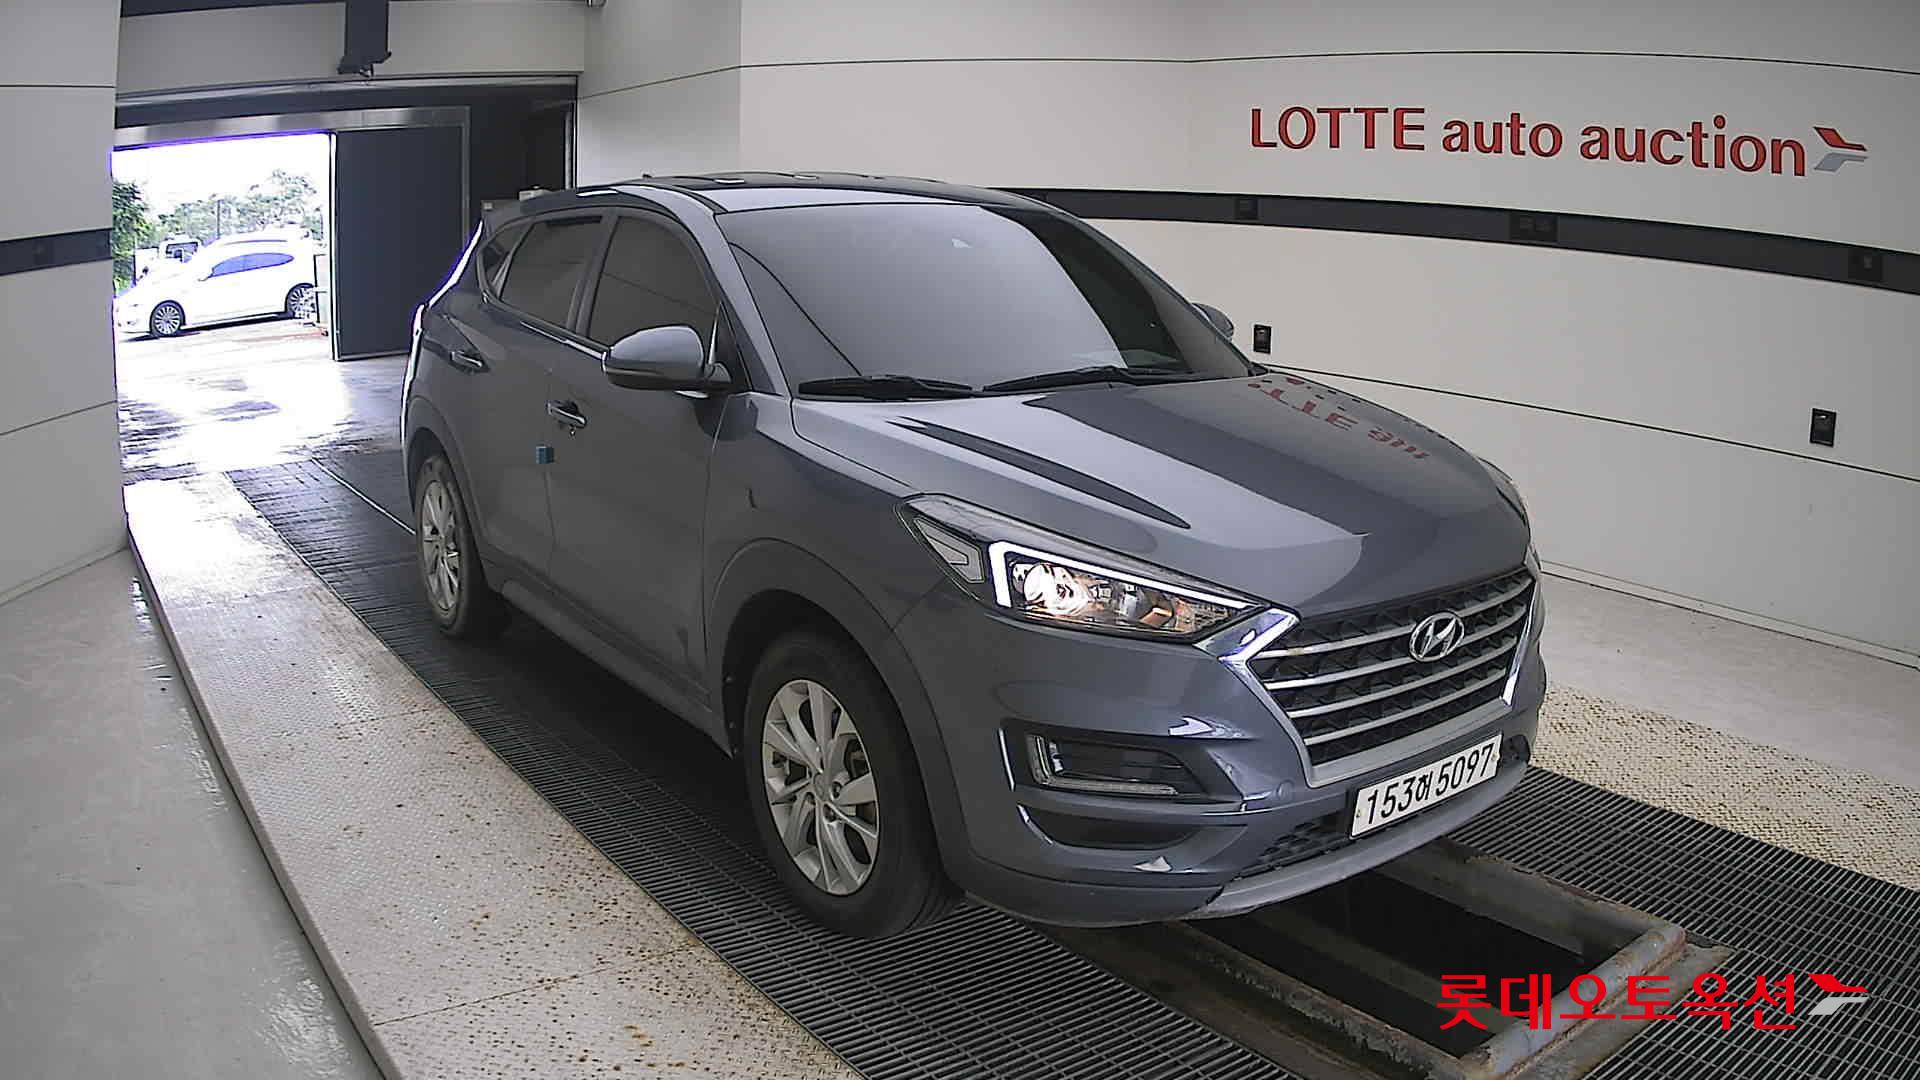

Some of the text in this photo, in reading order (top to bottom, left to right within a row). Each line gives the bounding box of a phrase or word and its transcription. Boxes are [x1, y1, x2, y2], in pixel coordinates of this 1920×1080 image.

[1250, 106, 1806, 176] LOTTE auto auction
